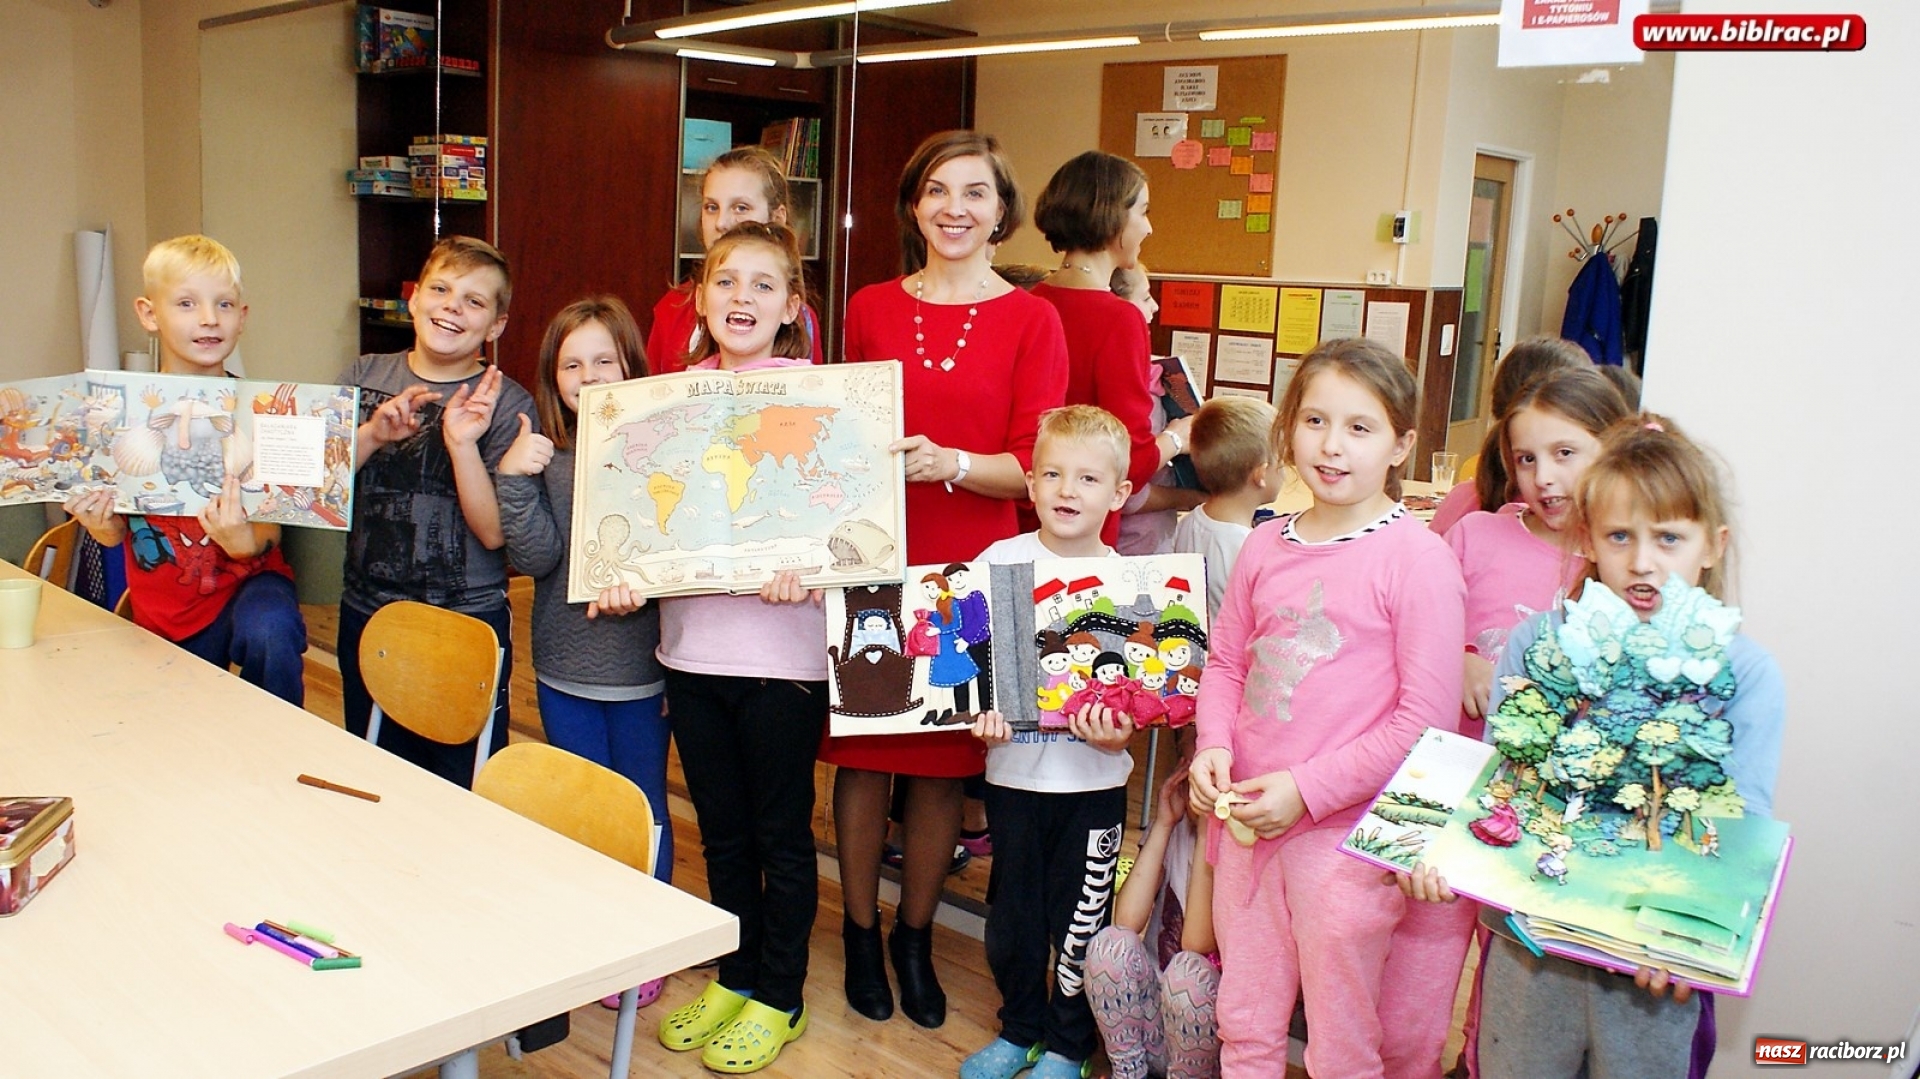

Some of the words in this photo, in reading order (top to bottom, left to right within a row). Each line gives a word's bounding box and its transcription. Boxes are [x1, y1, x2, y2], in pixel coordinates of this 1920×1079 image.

[1549, 3, 1594, 14] TYTONIU
[686, 379, 734, 398] MAPA
[735, 379, 787, 396] ŚWIATA
